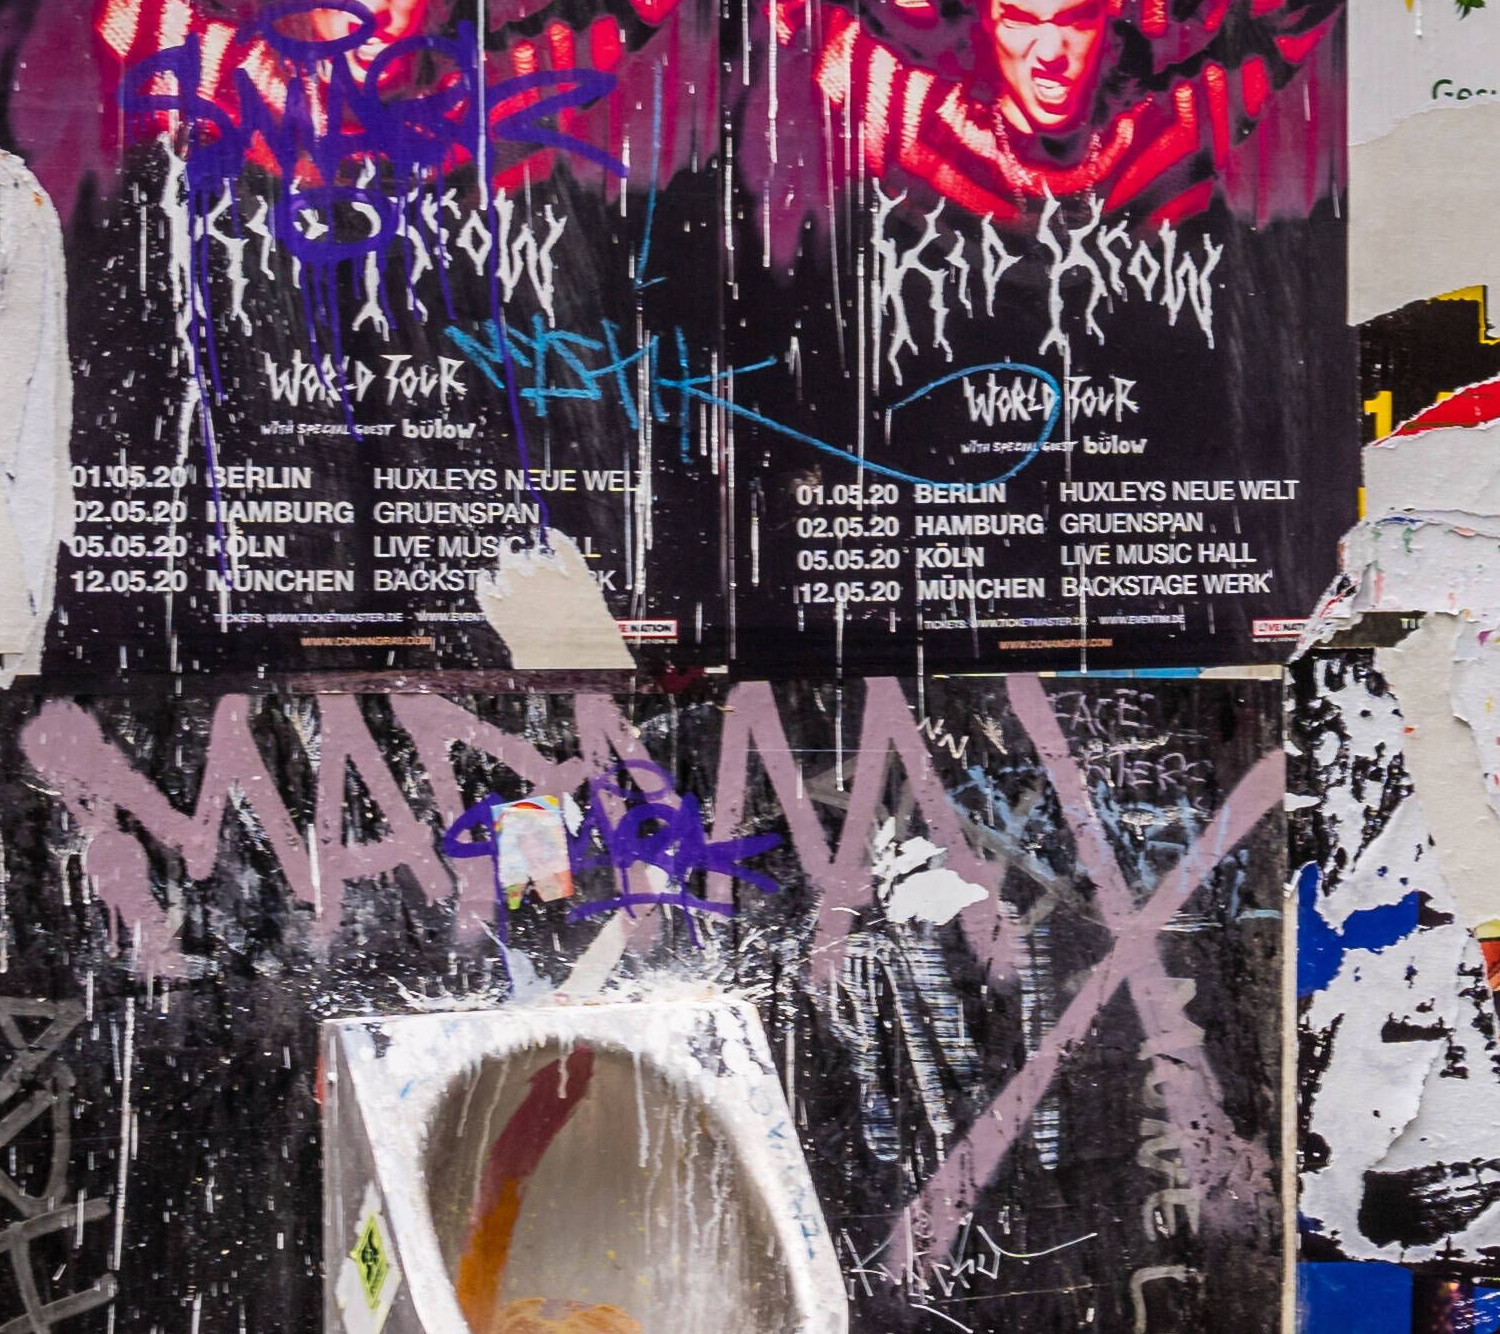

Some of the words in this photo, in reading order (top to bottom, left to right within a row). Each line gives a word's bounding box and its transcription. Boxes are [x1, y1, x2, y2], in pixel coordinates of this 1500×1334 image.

[871, 177, 1023, 386] KID
[1037, 181, 1224, 357] KROW
[381, 353, 469, 406] TOUR
[963, 375, 1061, 426] WORLD
[1065, 375, 1141, 422] TOUR
[402, 417, 476, 441] bülow
[993, 441, 1039, 453] SPECIAL
[1041, 440, 1079, 453] GUEST
[1083, 433, 1148, 454] bülow
[70, 466, 188, 489] 01.05.20
[207, 466, 311, 489] BERLIN
[373, 469, 499, 491] HUXLEYS
[504, 470, 577, 491] NEUE
[796, 484, 899, 507] 01.05.20
[915, 482, 1007, 504] BERLIN
[1060, 481, 1166, 503] HUXLEYS
[1172, 481, 1235, 502] NEUE
[1238, 480, 1299, 501] WELT
[72, 501, 188, 524] 02.05.20
[207, 501, 355, 524] HAMBURG
[373, 502, 541, 525] GRUENSPAN
[796, 516, 900, 538] 02.05.20
[915, 514, 1045, 537] HAMBURG
[1060, 512, 1203, 535] GRUENSPAN
[71, 534, 188, 558] 05.05.20
[373, 536, 423, 558] LIVE
[797, 548, 900, 571] 05.05.20
[1060, 543, 1111, 566] LIVE
[1116, 543, 1194, 565] MUSIC
[1197, 542, 1256, 564] HALL
[72, 570, 188, 592] 12.05.20
[207, 565, 355, 592] MÜNCHEN
[799, 580, 901, 603] 12.05.20
[916, 574, 1046, 600] MÜNCHEN
[1061, 575, 1198, 598] BACKSTAGE
[1203, 573, 1271, 596] WERK
